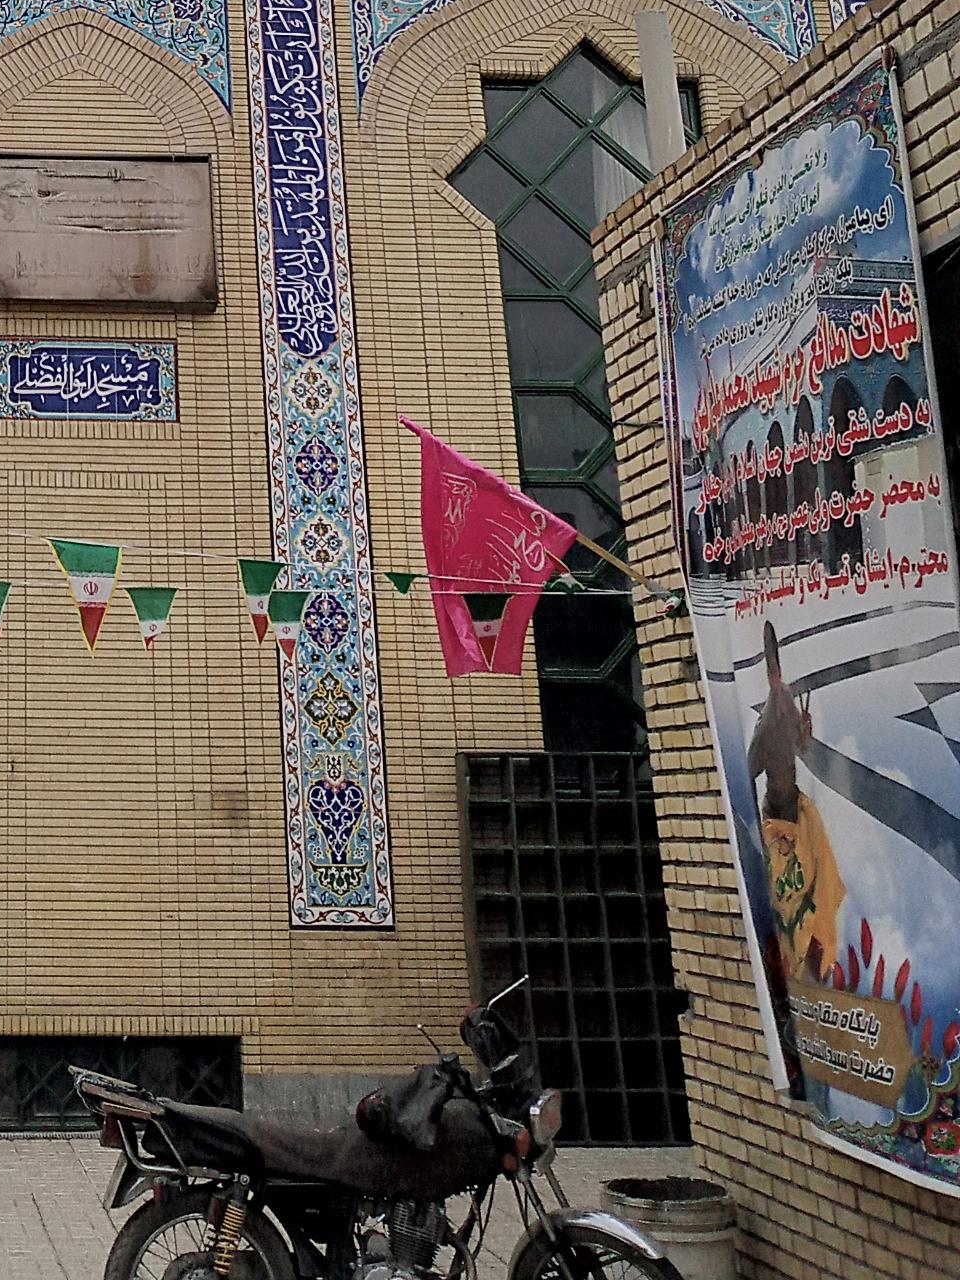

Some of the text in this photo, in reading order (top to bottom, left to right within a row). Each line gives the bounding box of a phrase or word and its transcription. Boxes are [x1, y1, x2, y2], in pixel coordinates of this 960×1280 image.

[803, 309, 852, 389] مدافع
[844, 282, 922, 374] شهادت
[748, 353, 785, 413] شهید
[779, 347, 809, 404] حرم
[871, 401, 913, 439] دست
[913, 397, 934, 433] به
[804, 486, 832, 532] ولی
[829, 484, 877, 529] حضرت
[875, 465, 926, 515] محضر
[924, 469, 943, 506] به
[851, 543, 895, 591] ایشان
[840, 1011, 880, 1046] پایگاه
[850, 1053, 896, 1083] حضرت
